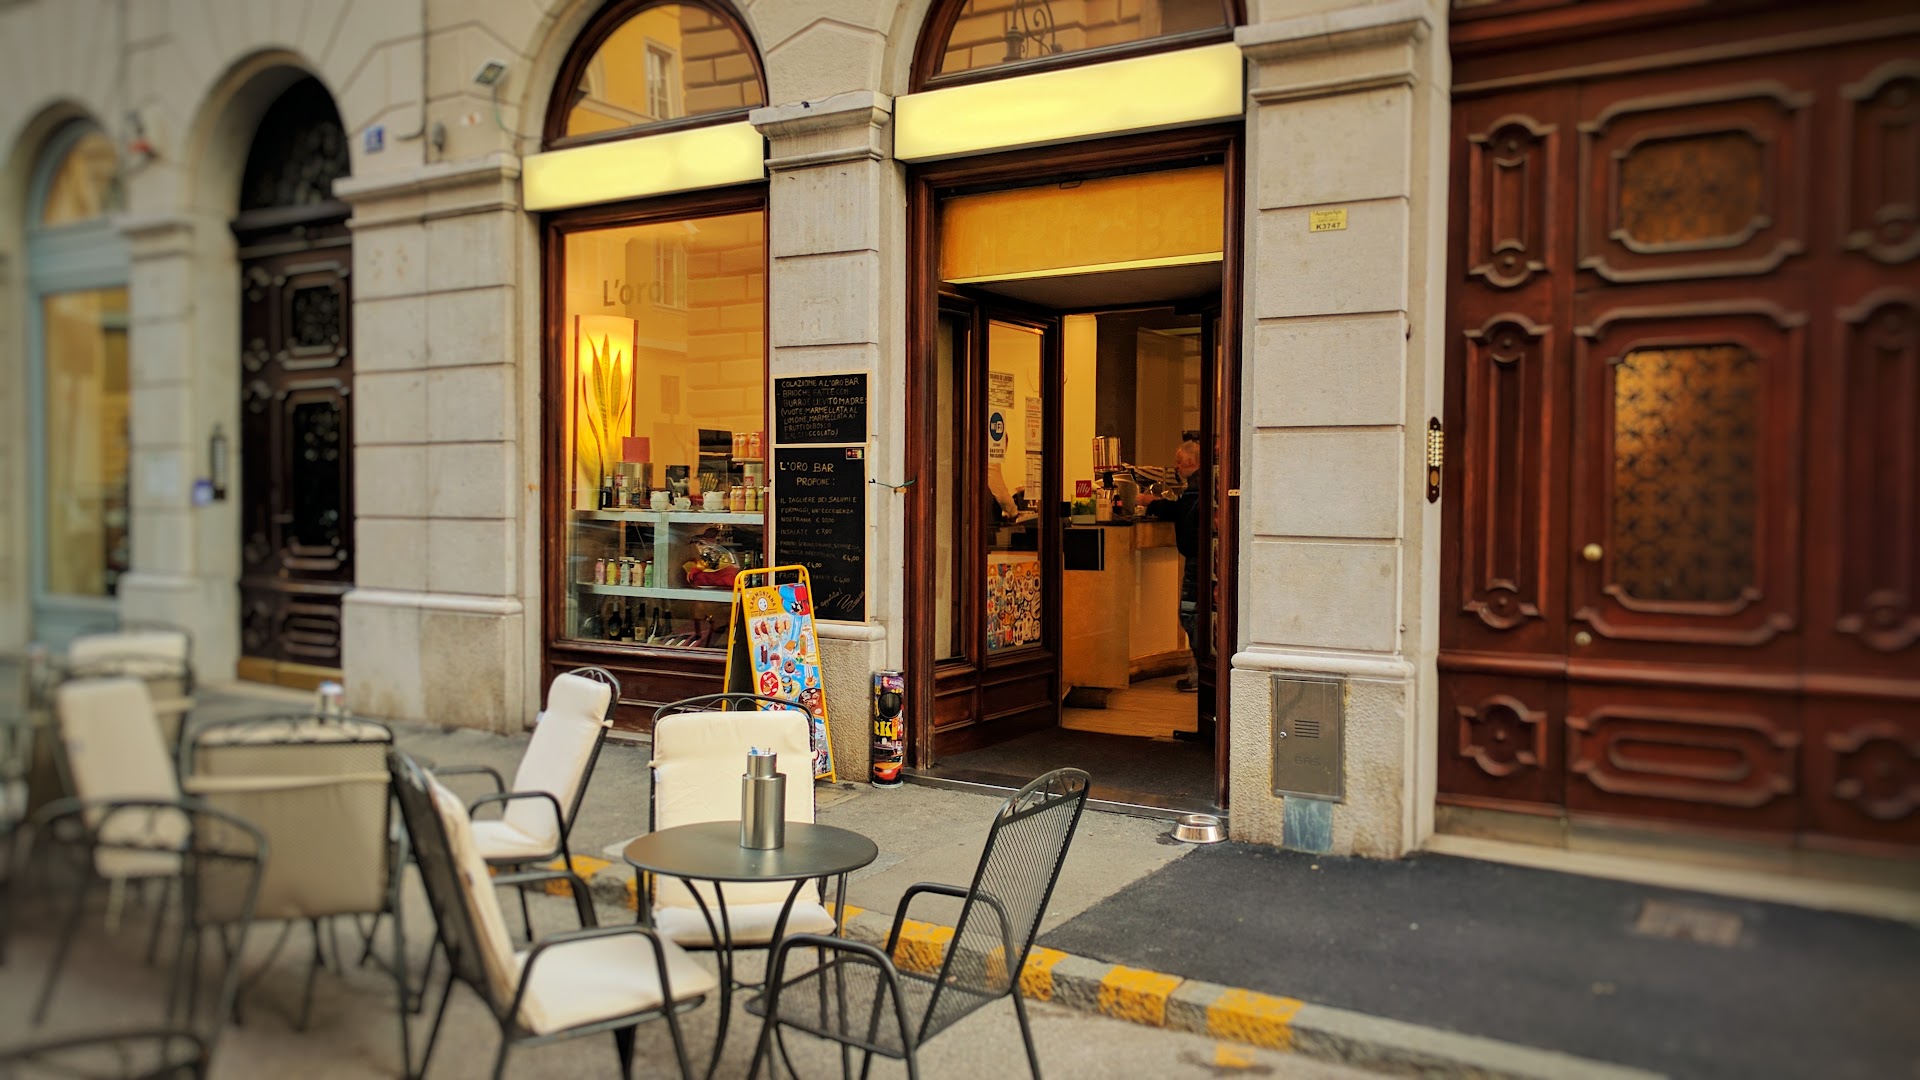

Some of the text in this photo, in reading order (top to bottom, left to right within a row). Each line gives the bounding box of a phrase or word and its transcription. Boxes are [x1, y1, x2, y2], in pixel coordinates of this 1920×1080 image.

[1316, 222, 1341, 230] K3747
[603, 279, 662, 307] L'oro
[781, 380, 817, 388] COLAZIONE
[845, 377, 860, 386] BAR
[813, 388, 835, 396] FATTE
[805, 405, 849, 414] MARMELLATA
[850, 405, 858, 414] AL
[809, 413, 847, 422] MARMELLATA
[784, 423, 805, 433] FRUTTI
[780, 461, 834, 473] L'ORO BAR
[1076, 482, 1091, 496] illy
[788, 496, 816, 504] TAGLIERE
[828, 495, 851, 503] SALUMI
[750, 590, 777, 609] SAMMONTANA
[1295, 756, 1321, 766] GAS
